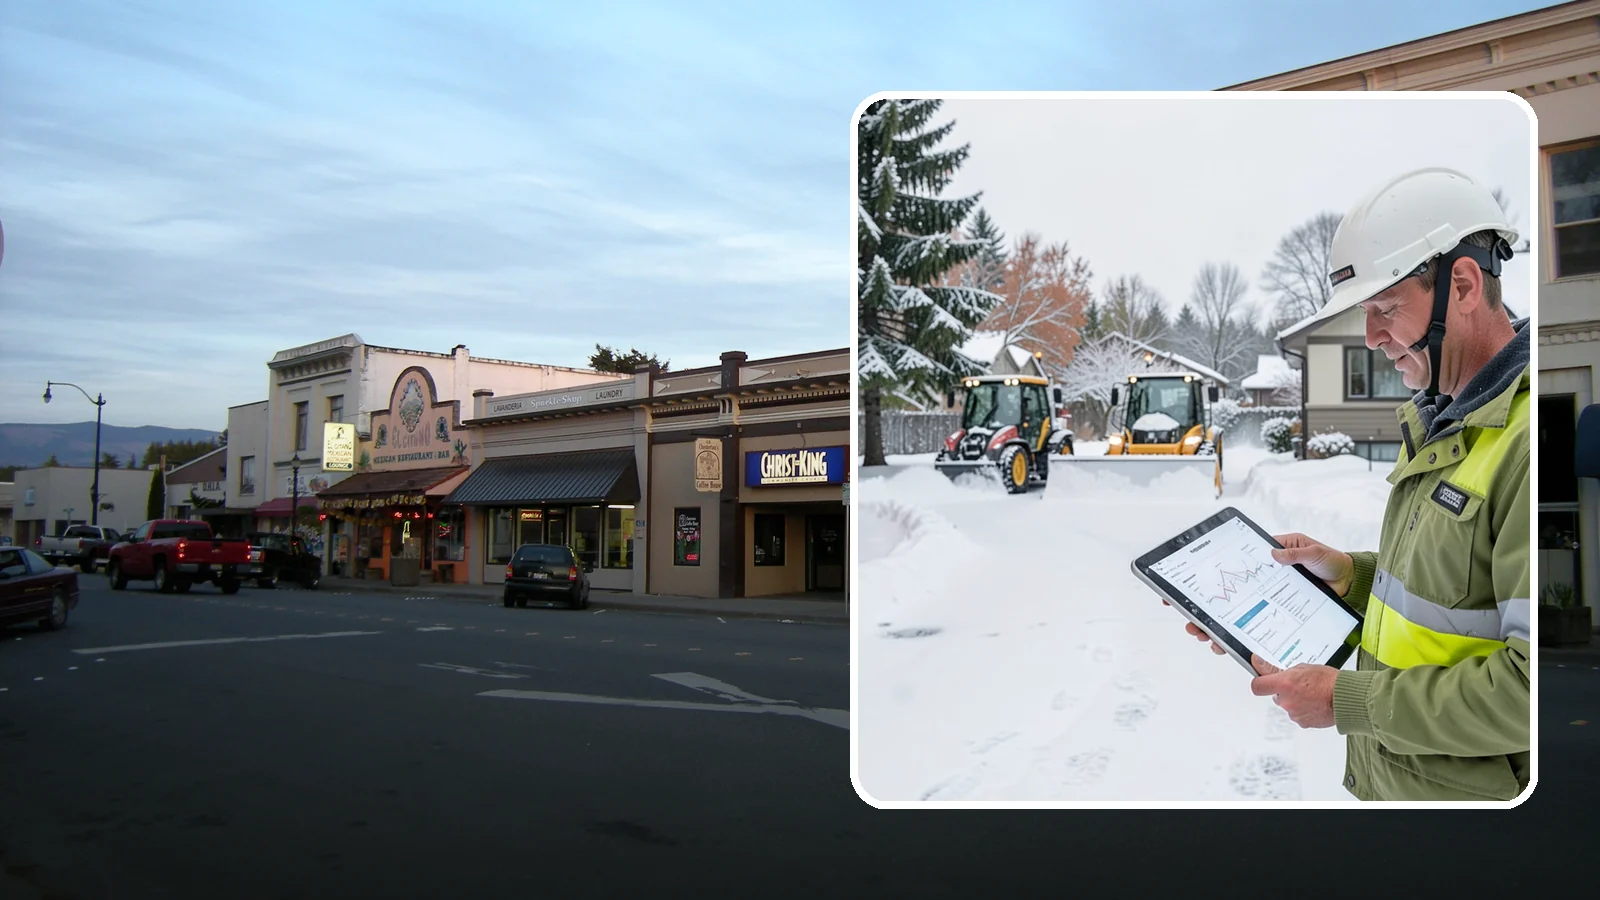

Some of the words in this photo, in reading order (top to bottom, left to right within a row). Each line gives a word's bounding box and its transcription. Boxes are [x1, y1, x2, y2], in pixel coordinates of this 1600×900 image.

[595, 389, 623, 399] LAUNDRY
[493, 402, 522, 412] LAVANDERIA
[531, 397, 561, 408] Sparkle
[561, 395, 582, 405] Shop
[374, 455, 396, 464] MEXICAN
[397, 451, 433, 462] RESTAURANT
[438, 450, 450, 459] BAR
[761, 452, 797, 477] CHRIST
[799, 450, 827, 476] KING
